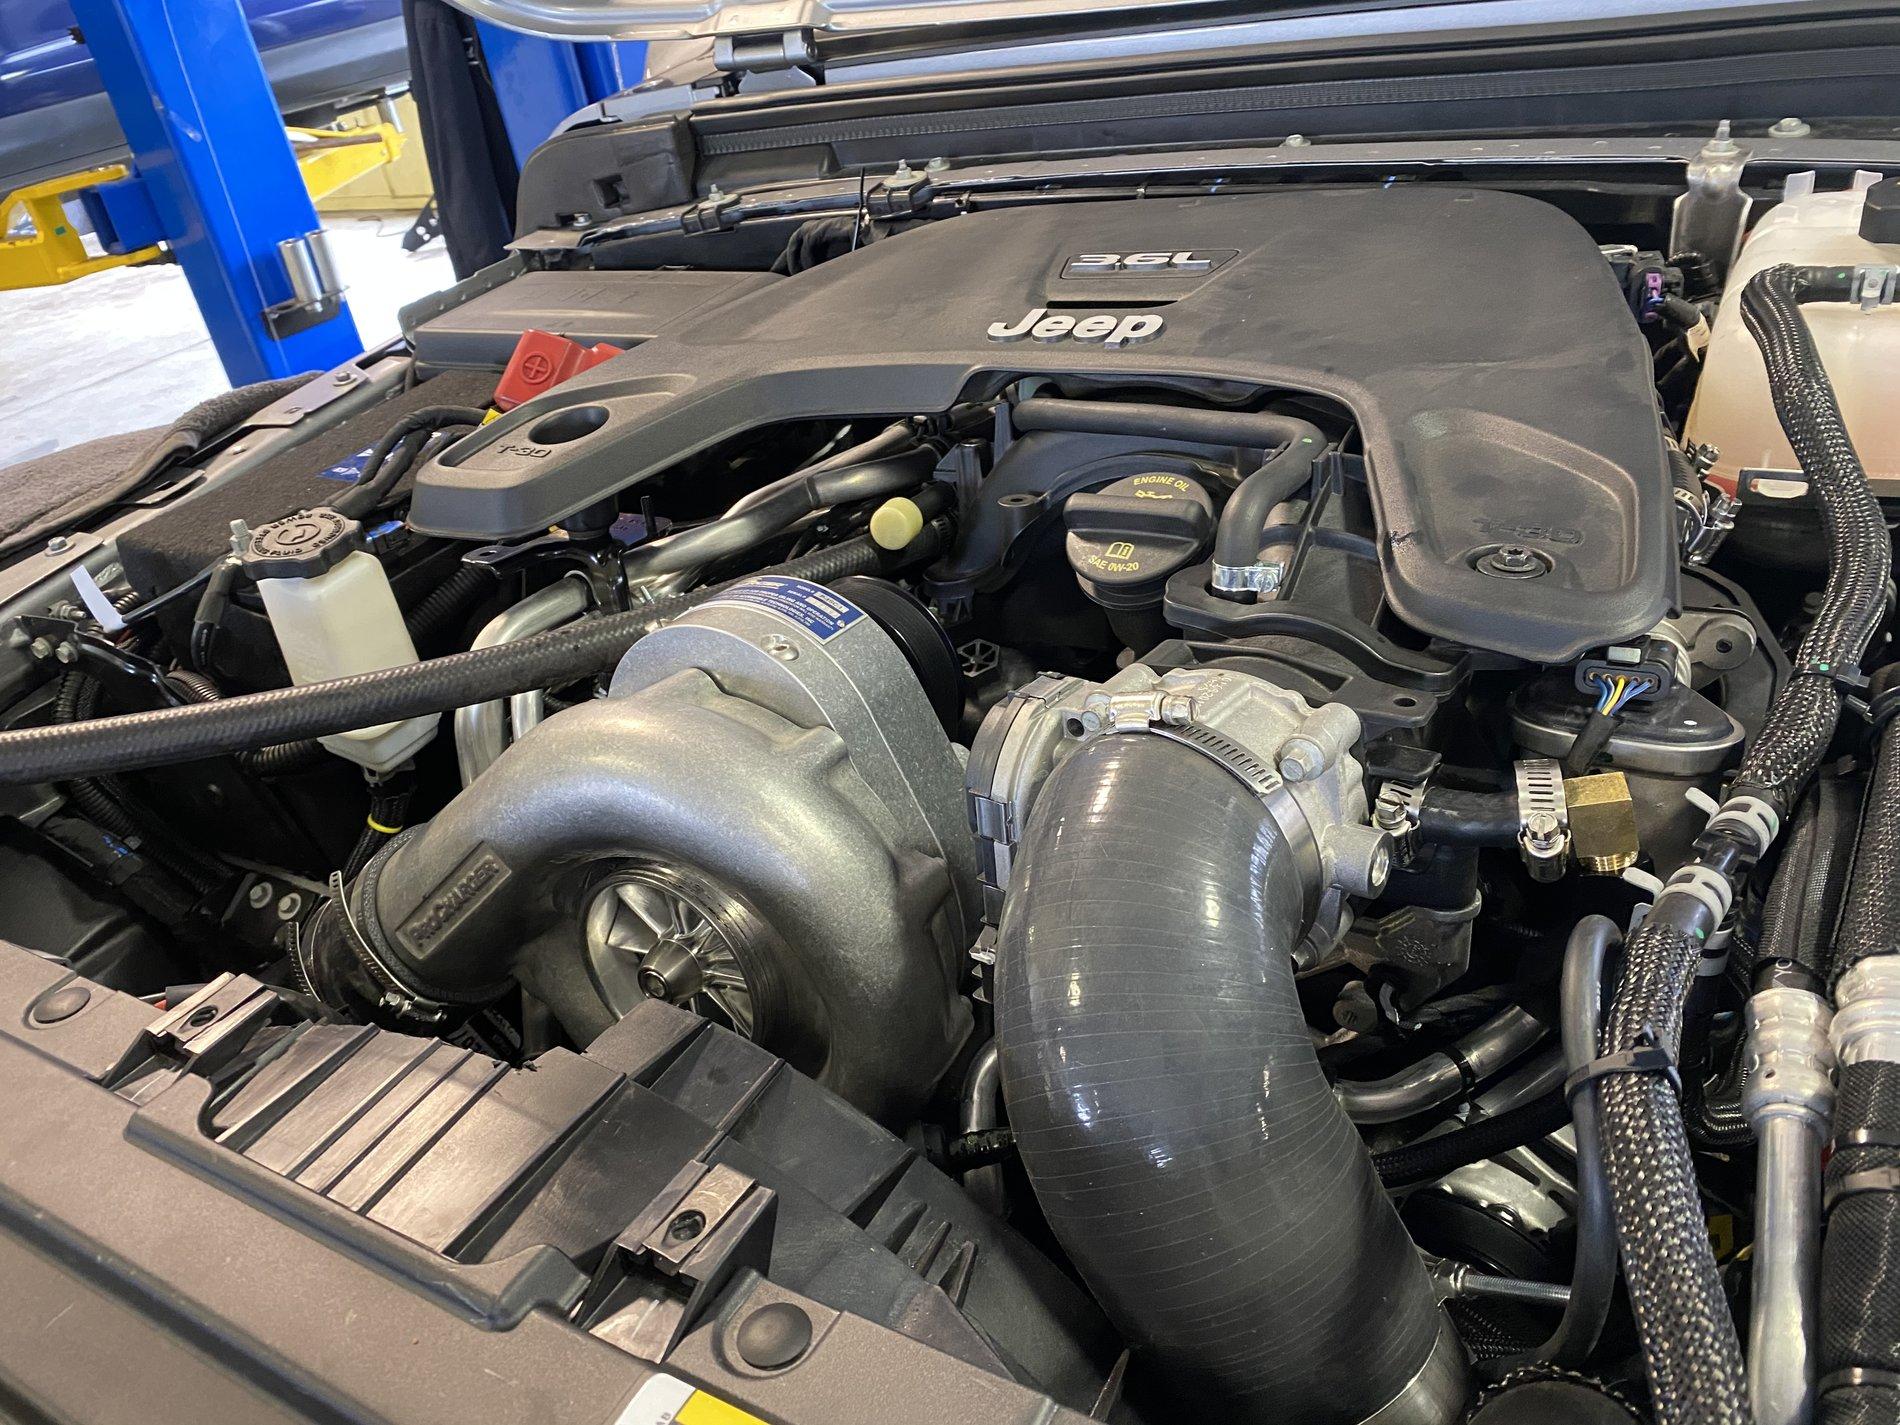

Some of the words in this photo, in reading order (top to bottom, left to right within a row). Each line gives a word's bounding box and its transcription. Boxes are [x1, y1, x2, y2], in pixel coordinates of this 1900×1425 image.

[1070, 250, 1212, 271] 3.6L
[986, 307, 1165, 349] Jeep
[1133, 475, 1175, 486] ENGINE
[1174, 480, 1190, 492] OIL
[1088, 554, 1109, 570] SAE
[1107, 562, 1139, 572] 0W-20
